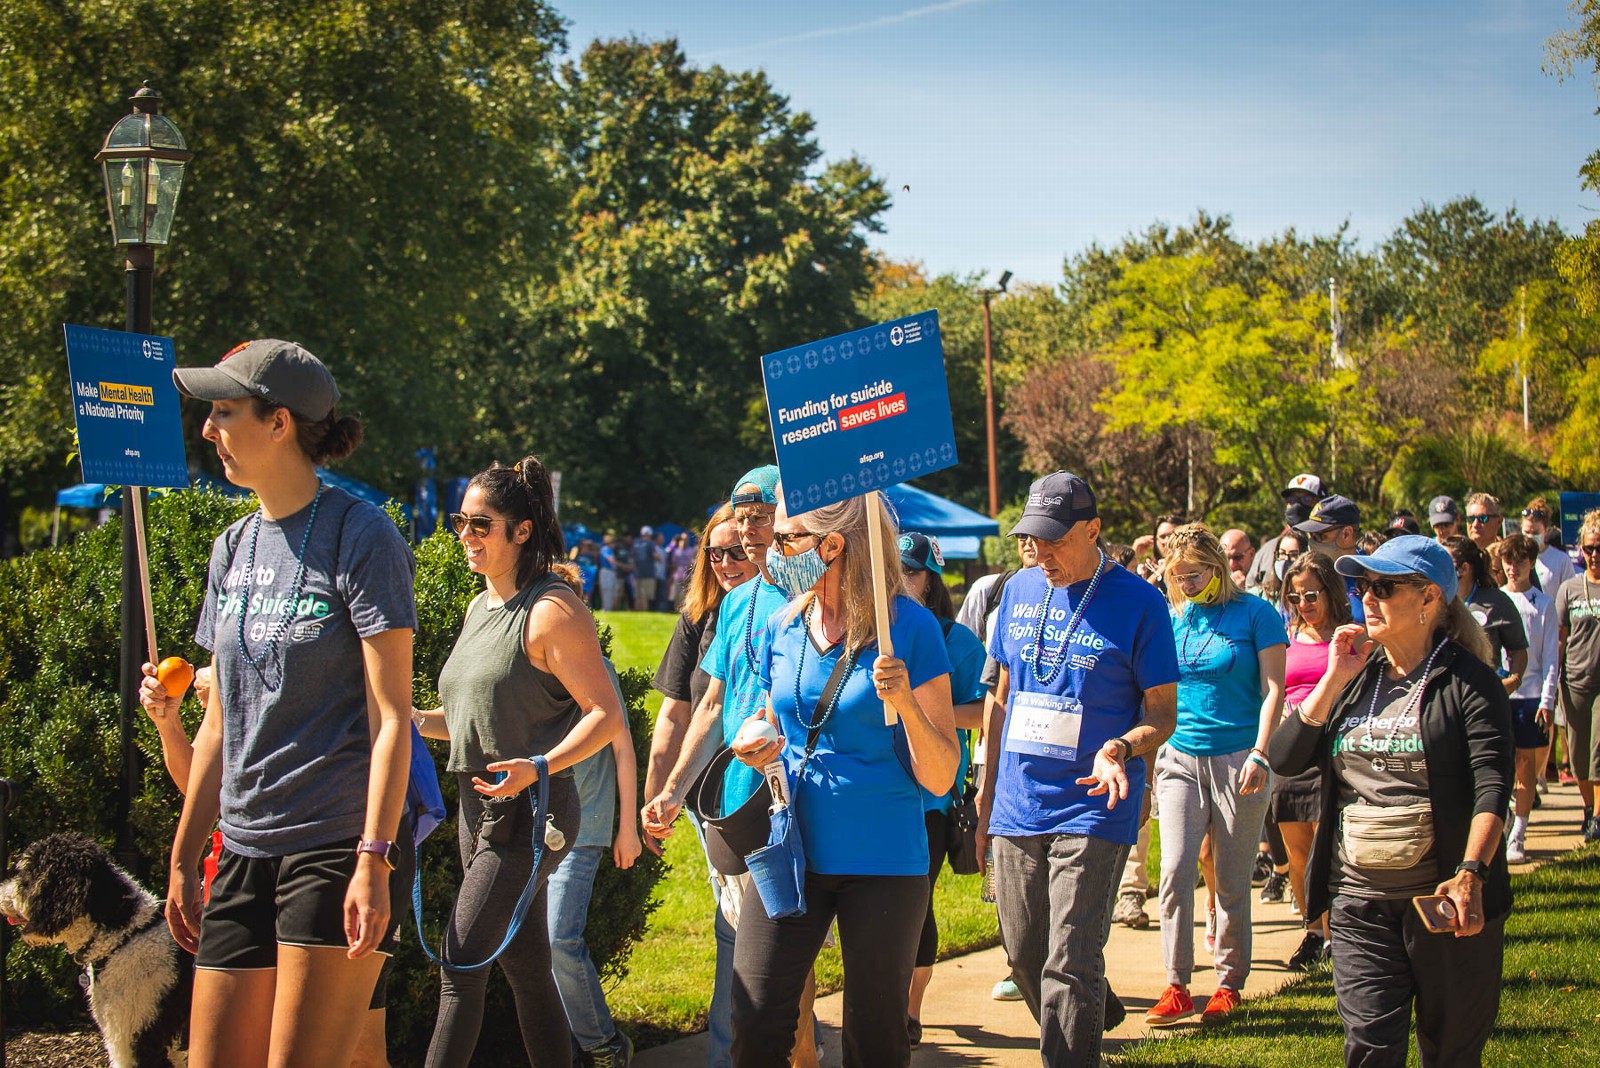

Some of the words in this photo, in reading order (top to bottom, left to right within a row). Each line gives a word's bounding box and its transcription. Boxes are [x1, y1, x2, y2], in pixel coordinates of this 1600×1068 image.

[77, 381, 99, 398] Make
[101, 385, 127, 401] Mental
[128, 387, 153, 403] Health
[778, 400, 829, 424] Funding
[830, 393, 848, 410] for
[851, 379, 893, 404] suicide
[79, 405, 85, 415] a
[85, 402, 116, 418] National
[117, 405, 144, 424] Priority
[782, 416, 837, 445] research
[841, 408, 876, 428] saves
[878, 399, 905, 417] lives
[859, 451, 884, 464] afsp.org
[256, 565, 275, 585] to
[1012, 603, 1045, 619] Wal
[1049, 606, 1066, 621] to
[1043, 624, 1104, 651] Sucide
[1030, 696, 1063, 711] Walking
[1064, 701, 1079, 712] For
[1397, 716, 1417, 728] to
